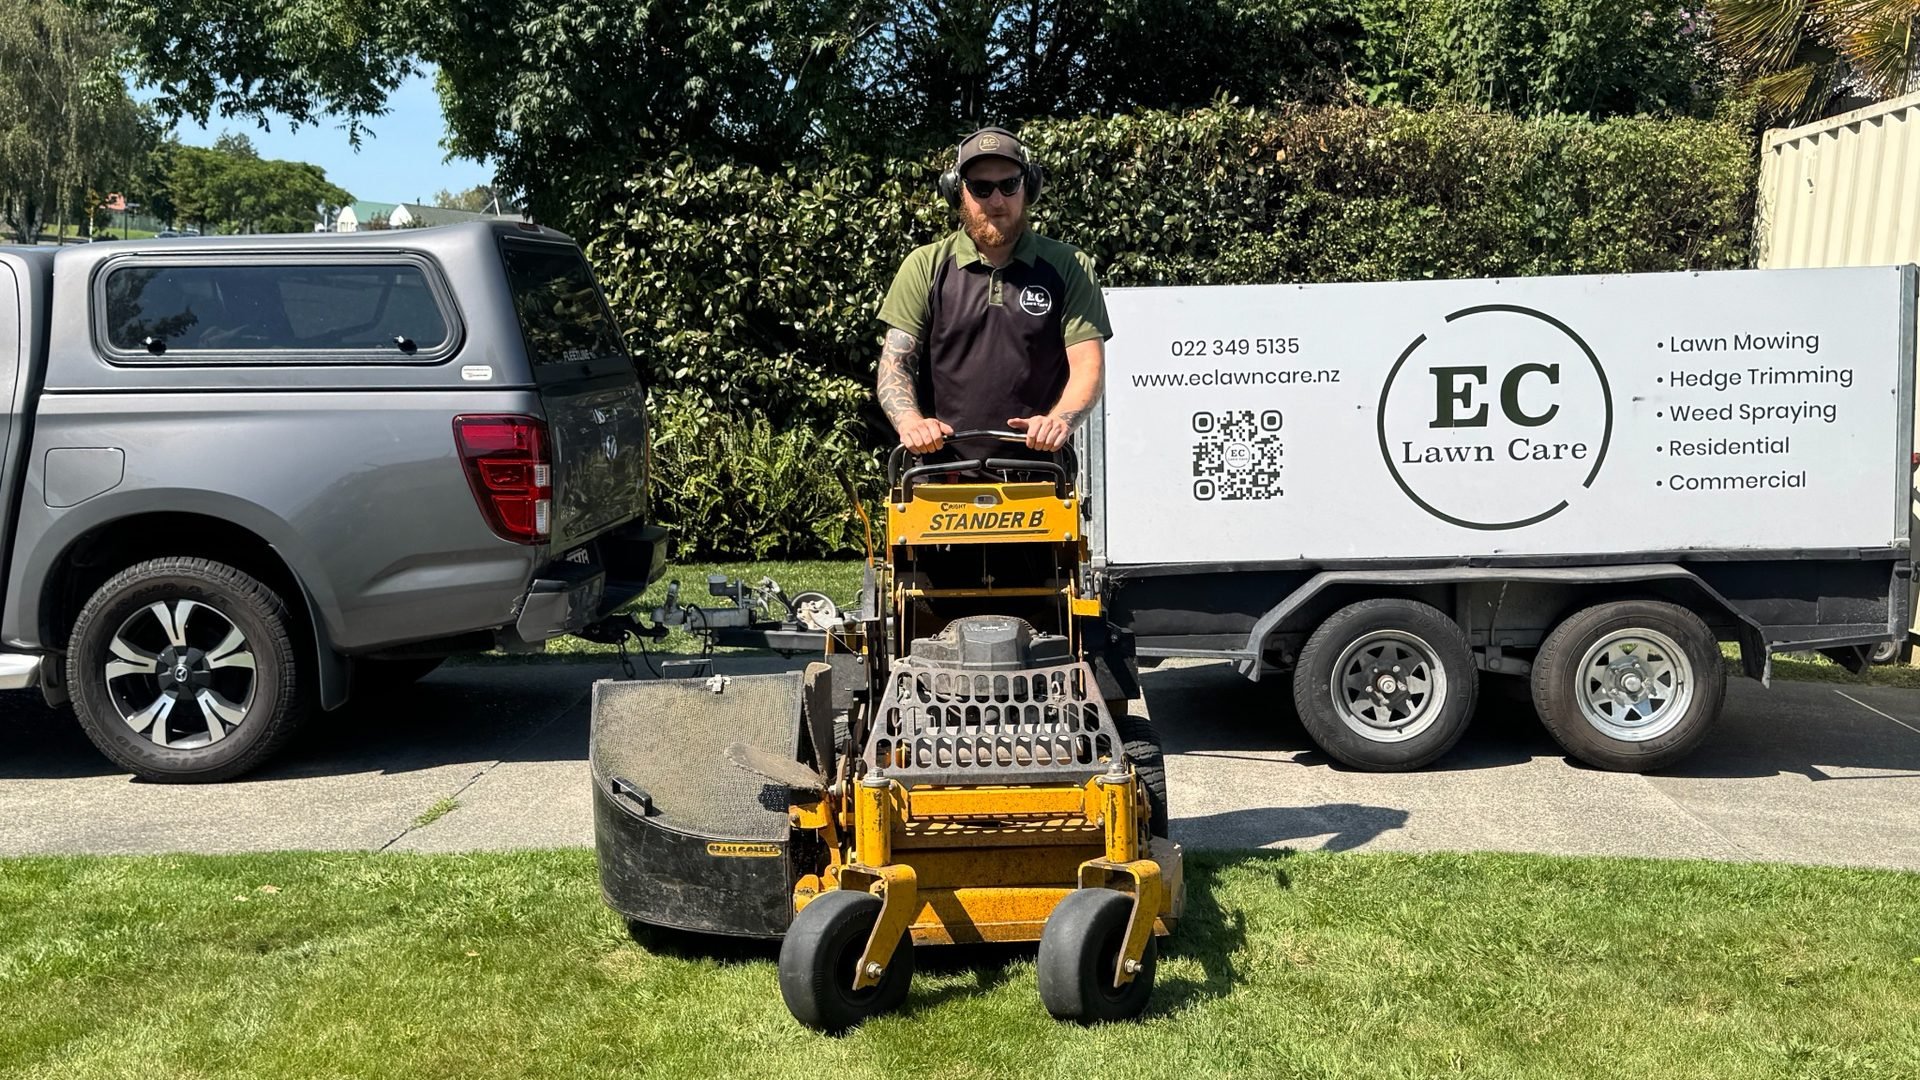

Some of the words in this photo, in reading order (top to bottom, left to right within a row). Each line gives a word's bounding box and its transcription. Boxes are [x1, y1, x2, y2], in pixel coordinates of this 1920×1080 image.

[1026, 290, 1045, 303] EC
[1171, 340, 1207, 357] 022
[1212, 338, 1250, 356] 349
[1256, 337, 1300, 355] 5135
[1671, 336, 1728, 354] Lawn
[1734, 332, 1820, 354] Mowing
[1131, 368, 1340, 388] www.eclawncare.nz
[1670, 368, 1742, 391] Hedge
[1747, 365, 1854, 389] Trimming
[1428, 362, 1561, 429] EC
[1669, 402, 1734, 422] Weed
[1739, 400, 1838, 426] Spraying
[1231, 449, 1245, 457] EC
[1402, 441, 1496, 464] Lawn
[1508, 438, 1588, 461] Care
[1670, 436, 1791, 457] Residential
[1669, 470, 1807, 492] Commercial
[929, 511, 1026, 531] STANDER
[1028, 508, 1045, 528] B
